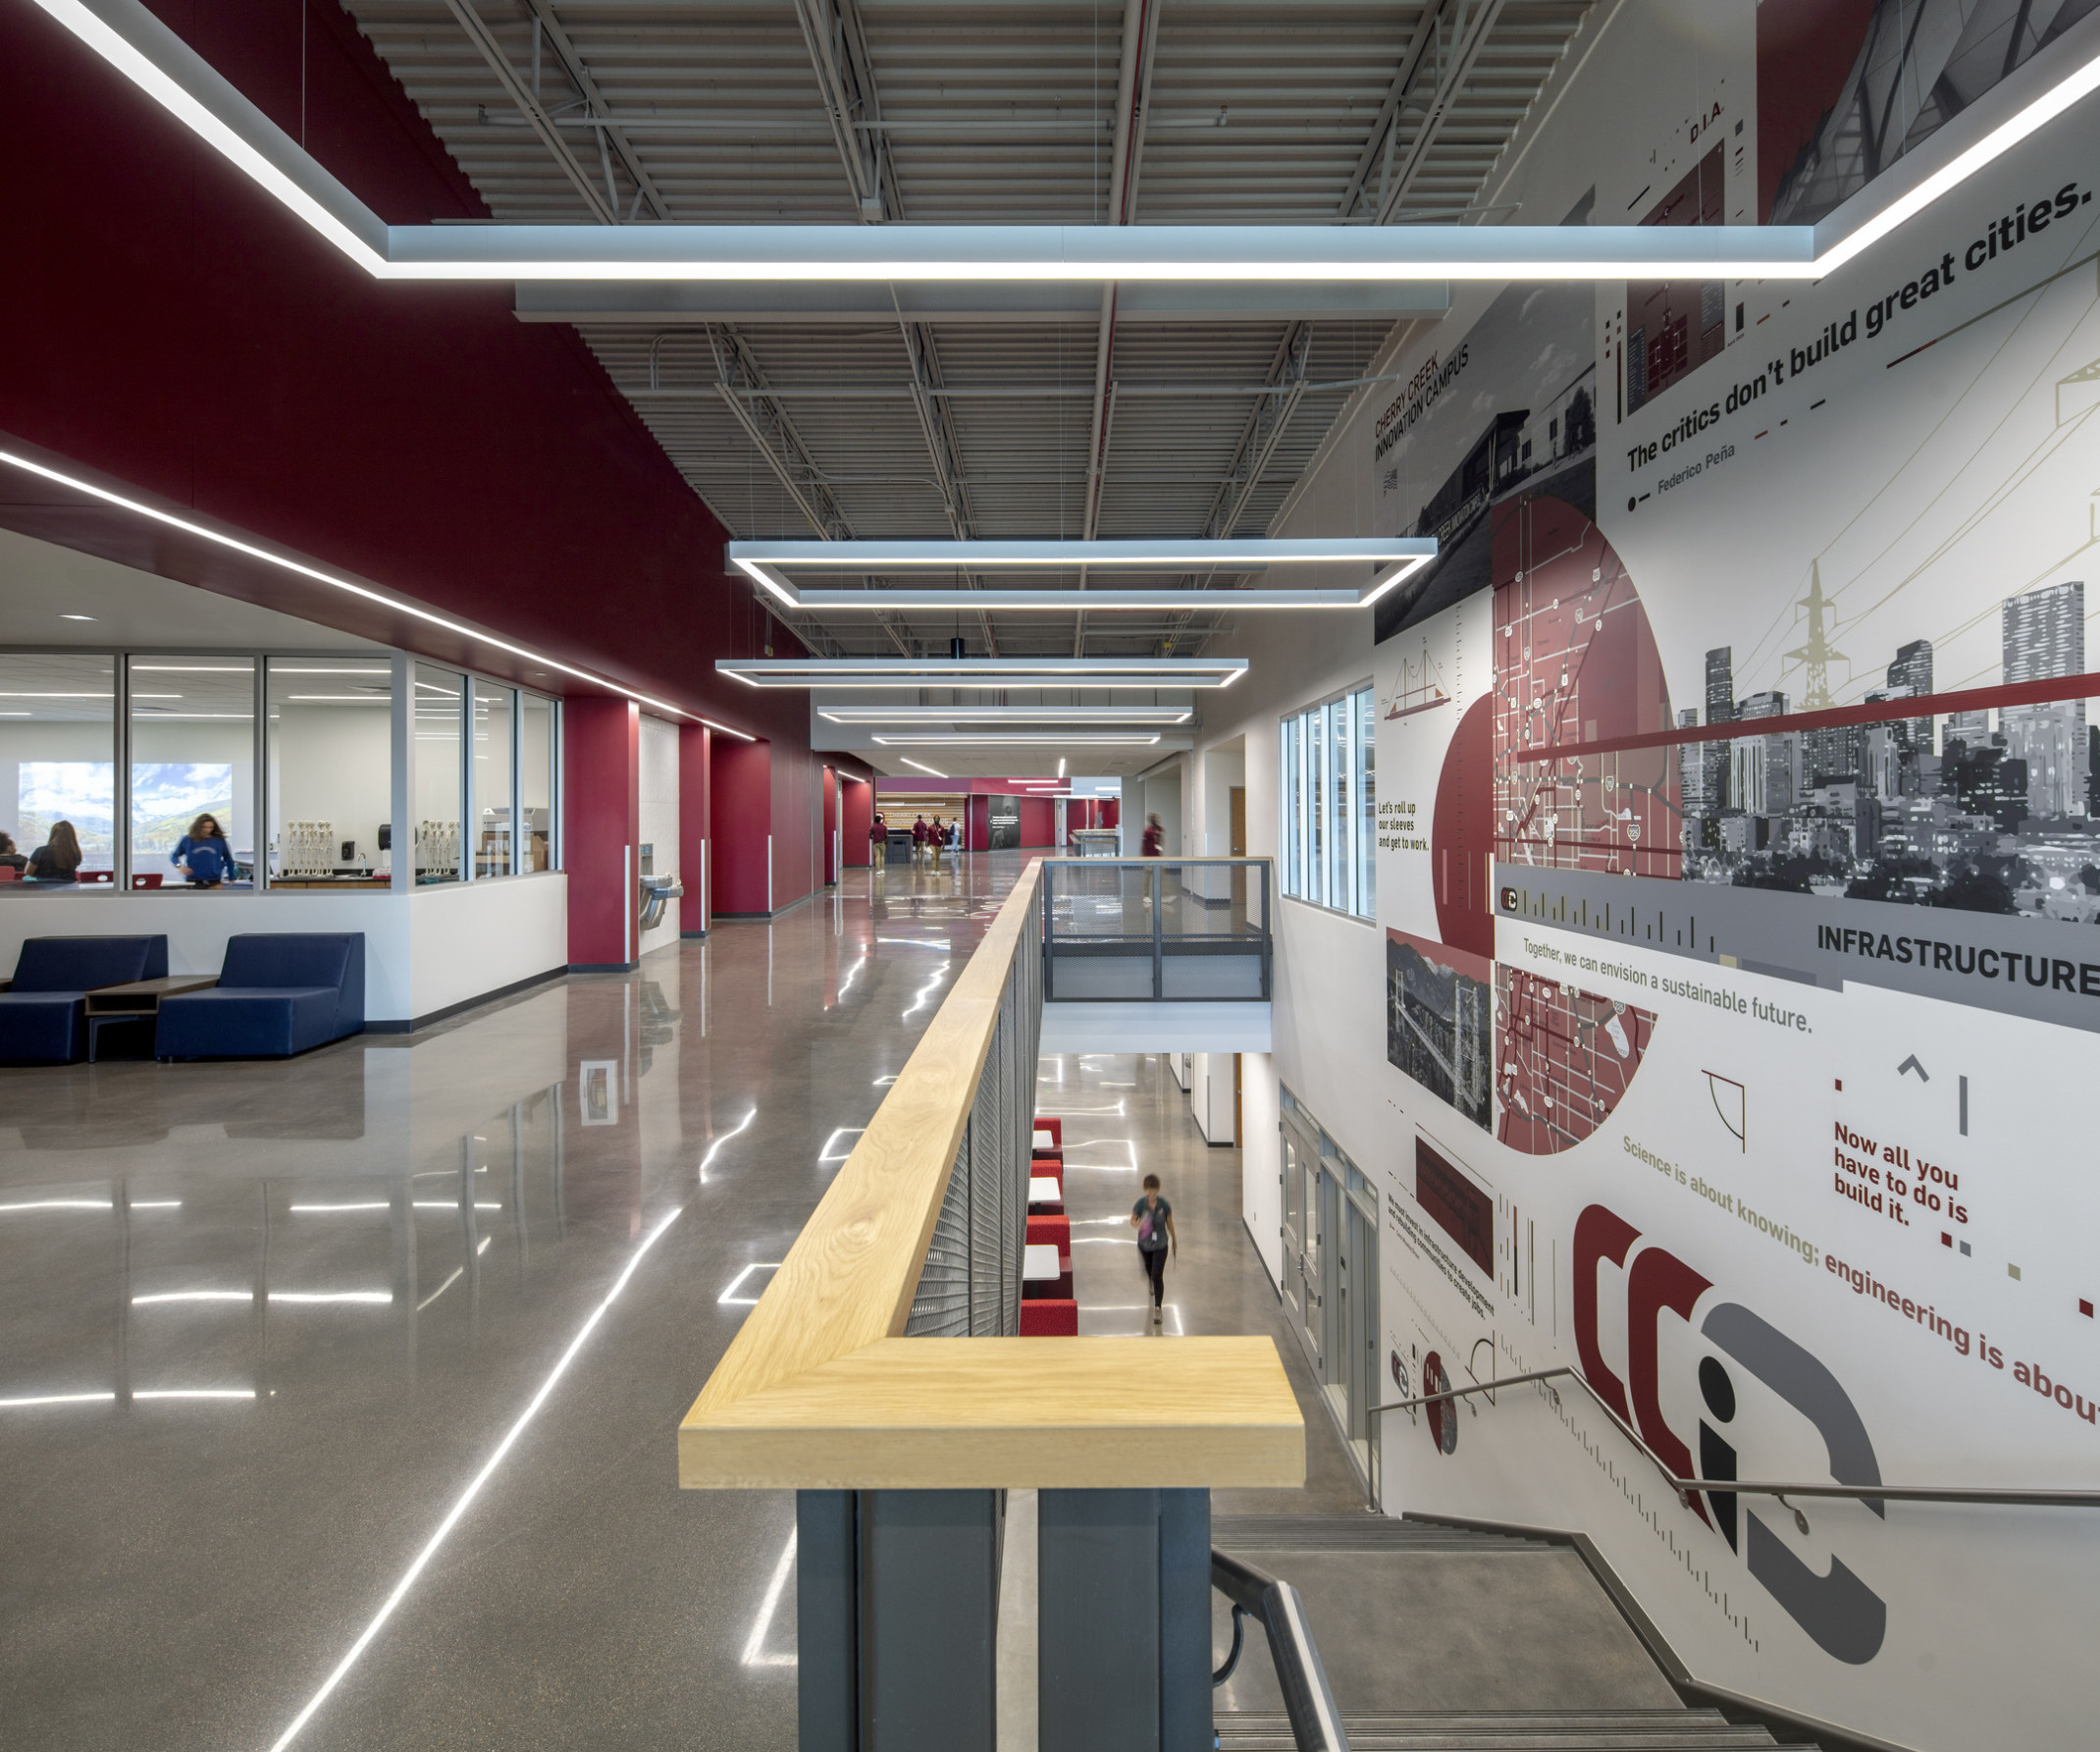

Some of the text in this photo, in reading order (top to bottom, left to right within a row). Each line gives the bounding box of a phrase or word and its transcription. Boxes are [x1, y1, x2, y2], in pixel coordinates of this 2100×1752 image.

[1690, 101, 1725, 144] D.I.A.
[1627, 442, 1657, 472] The
[1661, 402, 1720, 452] critics
[1725, 359, 1784, 415] don't
[1790, 309, 1858, 378] build
[1865, 252, 1956, 340] great
[1965, 183, 2092, 272] cities.
[1375, 350, 1439, 439] CHERRY CREEK
[1375, 344, 1469, 462] INNOVATION CAMPUS
[1657, 445, 1736, 495] Federico Peña
[1379, 801, 1416, 817] Let's roll up
[1379, 818, 1414, 831] our sleeves
[1379, 835, 1429, 851] and get to work.
[1523, 937, 1813, 1034] Together, we can envision a sustainable future.
[1817, 924, 2100, 998] INFRASTRUCTURE
[1834, 1121, 1959, 1192] Now all you
[1834, 1146, 1969, 1224] have to do is
[1834, 1172, 1910, 1227] build it.
[1623, 1135, 2100, 1425] Science is about knowing; engineering is abou
